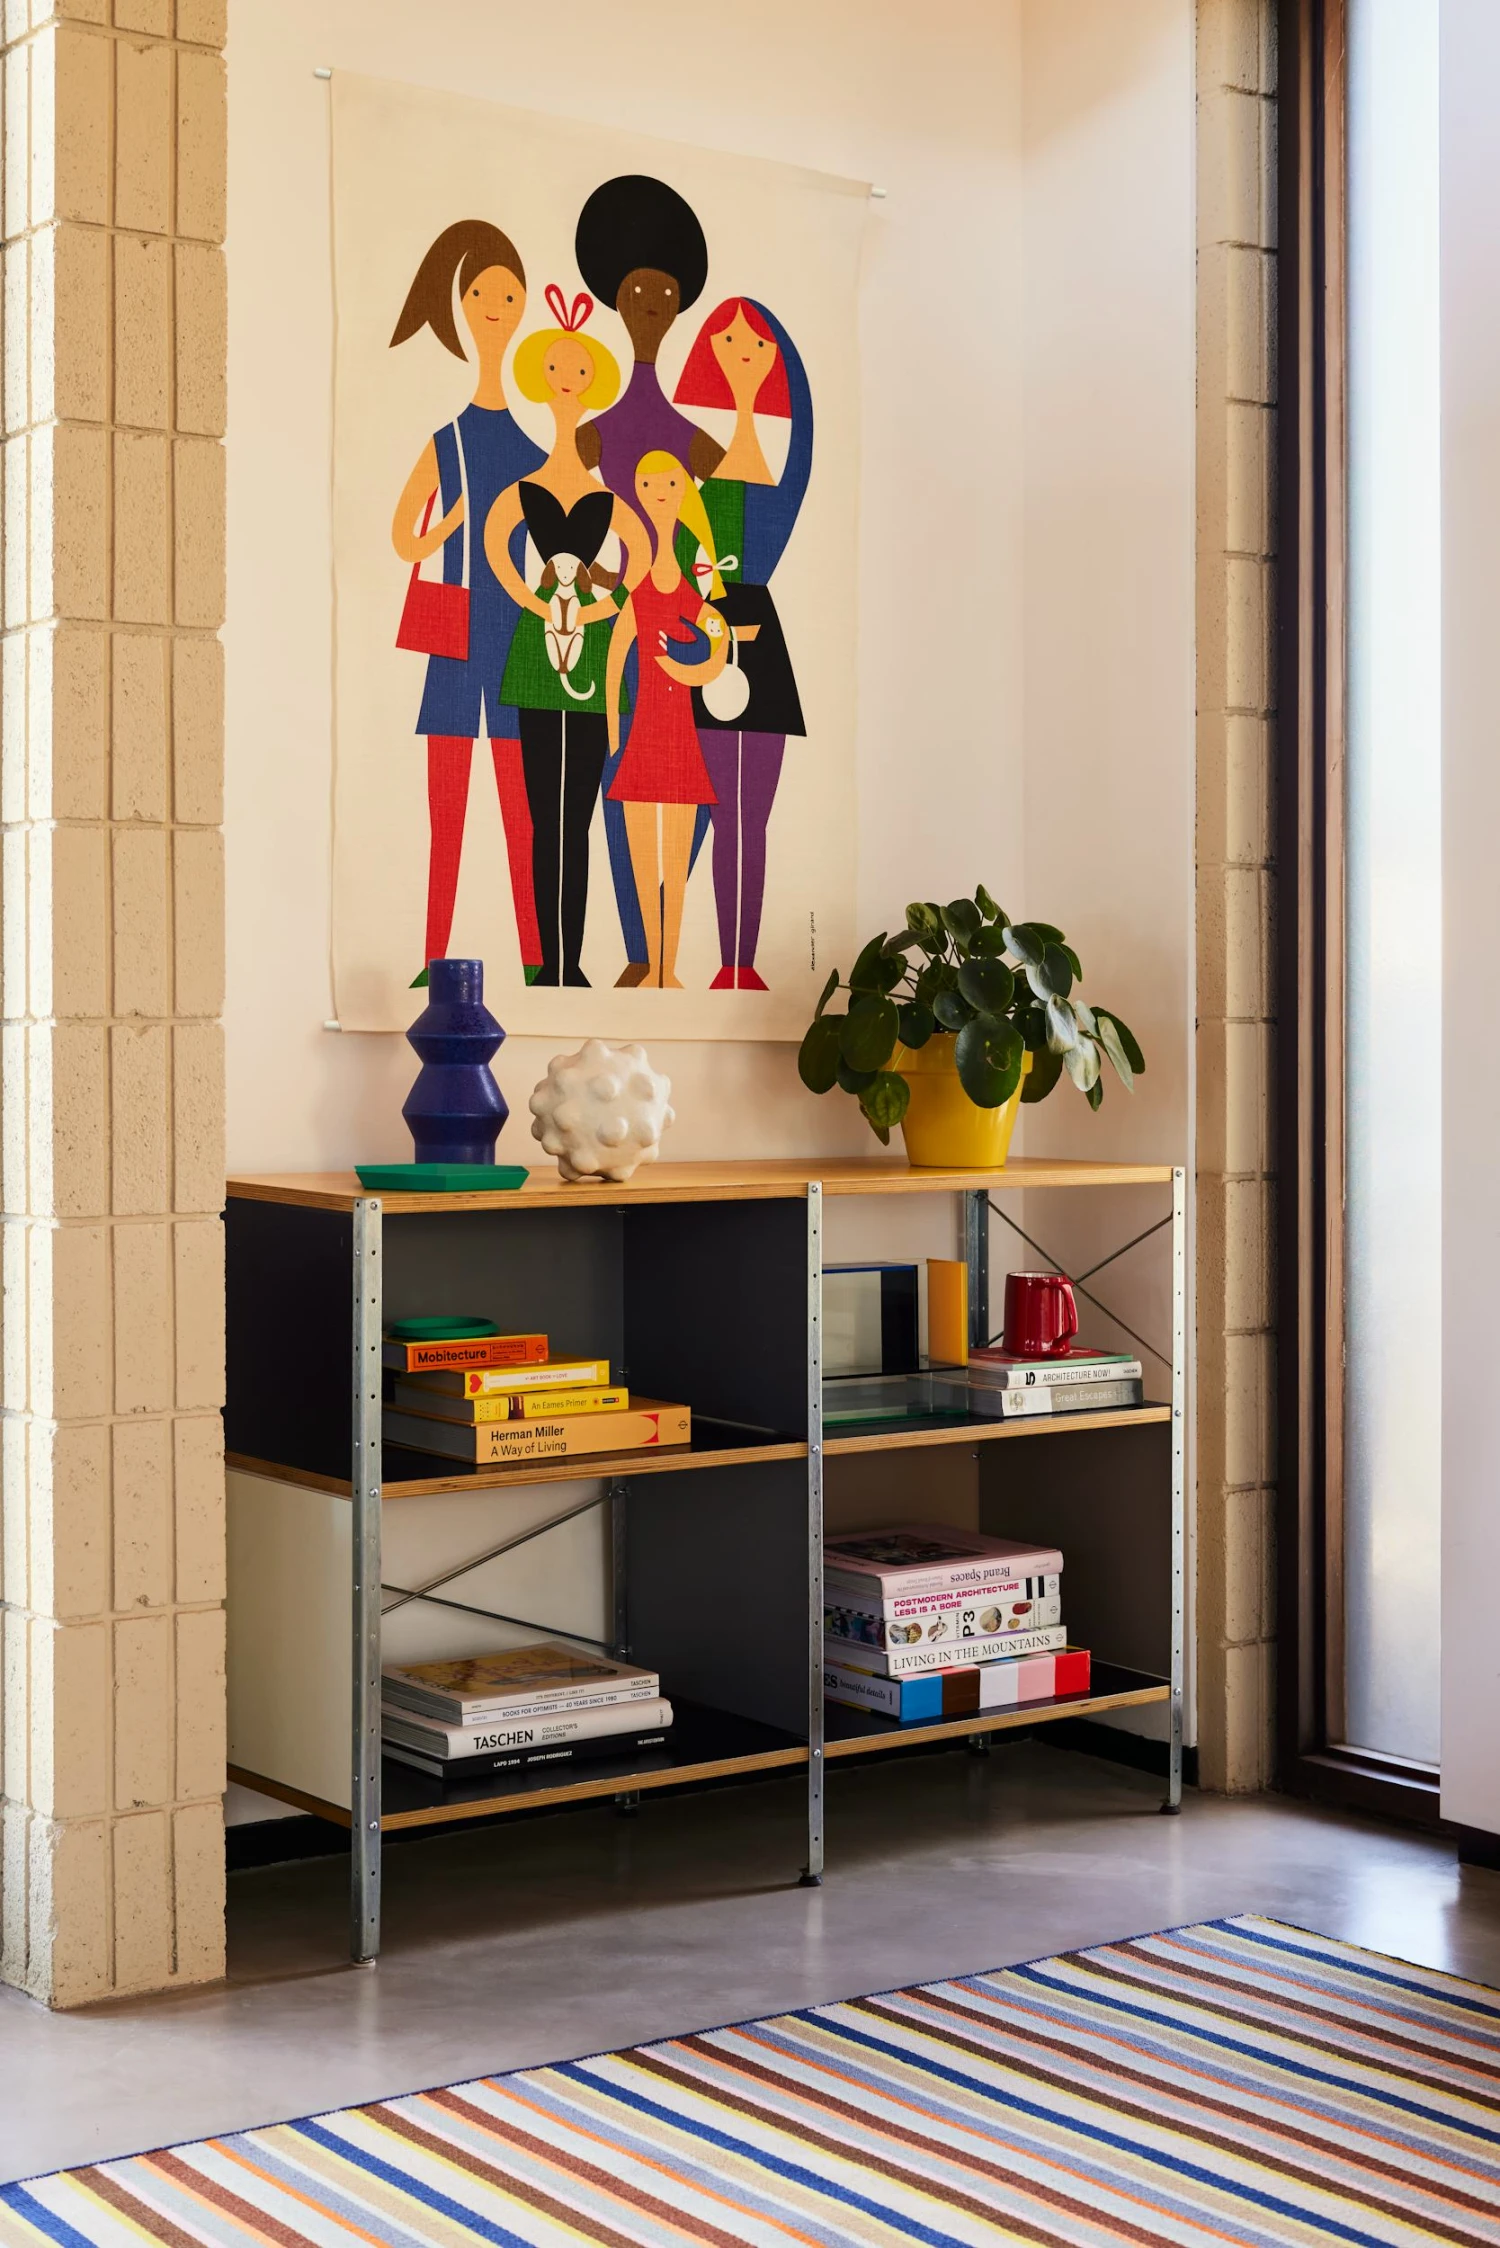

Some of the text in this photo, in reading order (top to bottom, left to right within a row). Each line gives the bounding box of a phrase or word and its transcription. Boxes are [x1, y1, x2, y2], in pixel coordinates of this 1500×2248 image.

[417, 1349, 487, 1363] Mobitecture
[1042, 1370, 1091, 1382] ARCHITECTURE
[1092, 1369, 1111, 1378] NOW!
[1055, 1392, 1077, 1403] Great
[1079, 1389, 1113, 1402] Escapes
[531, 1399, 588, 1410] An Eames Primer
[491, 1425, 564, 1442] Herman Miller
[490, 1440, 567, 1457] A Way of Living
[950, 1568, 981, 1583] Spaces
[983, 1566, 1011, 1580] Brand
[893, 1592, 954, 1608] POSTMODERN
[955, 1582, 1020, 1598] ARCHITECTURE
[894, 1600, 962, 1617] LESS IS A BORE
[962, 1610, 975, 1638] P3
[893, 1635, 1051, 1670] LIVING IN THE MOUNTAINS
[630, 1691, 651, 1699] TASCHEN
[866, 1686, 886, 1699] details
[502, 1709, 520, 1718] BOOKS
[532, 1704, 558, 1713] OPTIMISTS
[565, 1700, 573, 1708] 40
[573, 1699, 589, 1707] YEARS
[589, 1697, 604, 1705] SINCE
[541, 1722, 578, 1734] COLLECTOR'S
[473, 1729, 533, 1750] TASCHEN
[541, 1732, 566, 1741] EDITIONS
[526, 1750, 573, 1763] JOSEPH RODRIGUEZ
